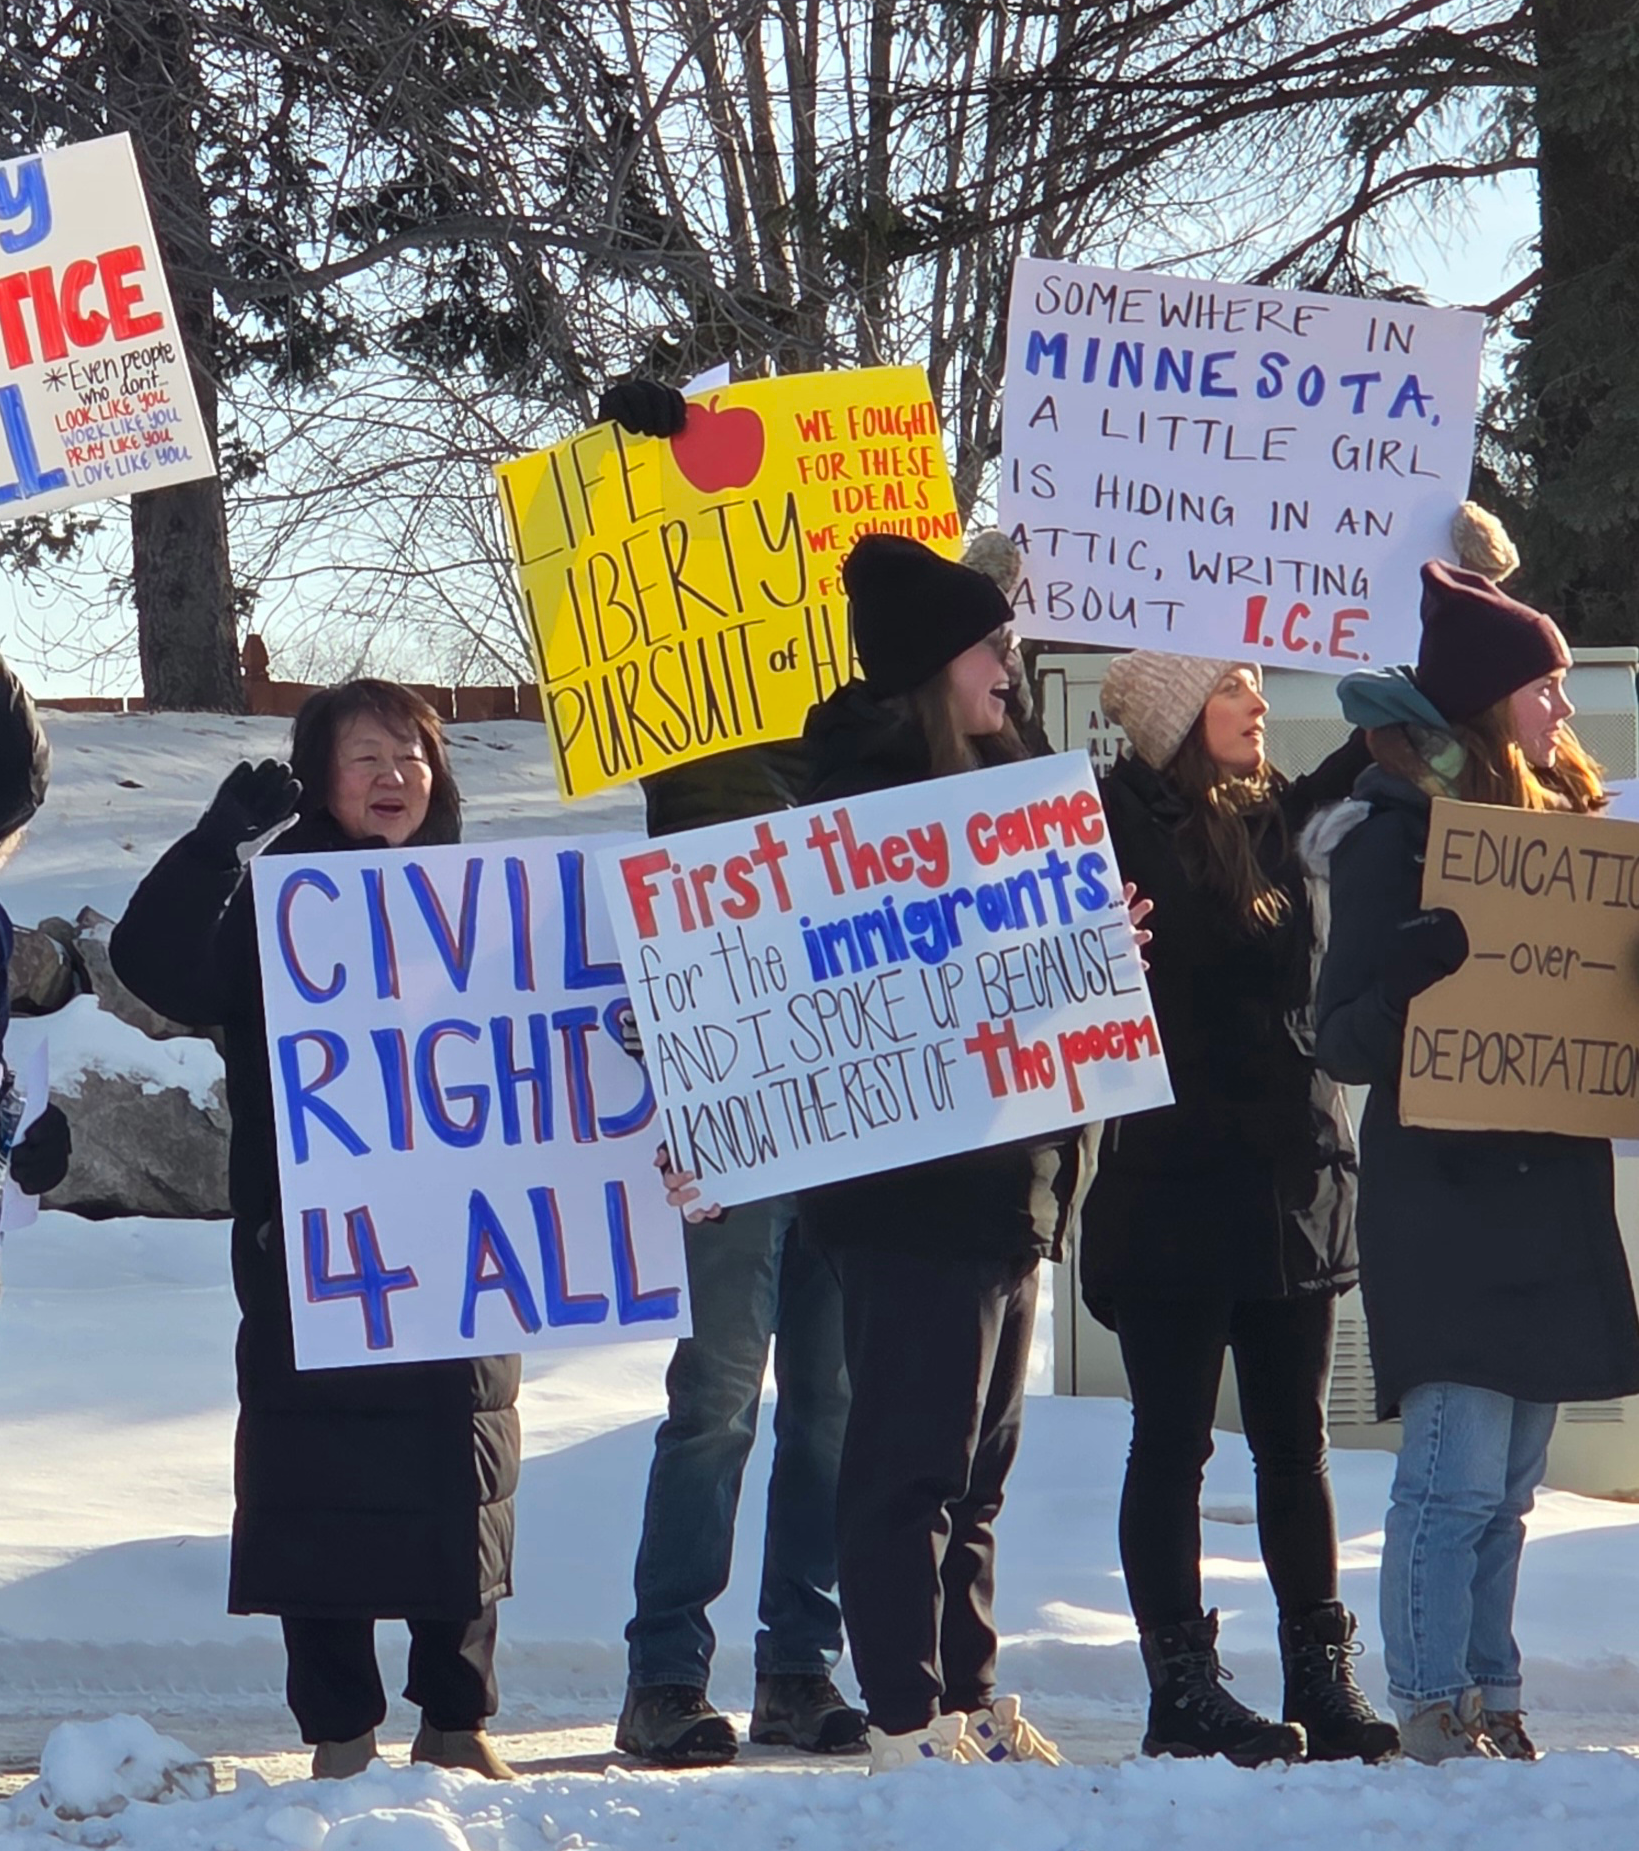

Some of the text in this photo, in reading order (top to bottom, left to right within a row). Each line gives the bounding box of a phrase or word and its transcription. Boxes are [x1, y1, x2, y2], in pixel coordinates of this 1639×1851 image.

[1035, 275, 1416, 354] SOMEWHERE IN
[78, 386, 109, 405] who
[121, 341, 175, 378] people
[1025, 330, 1441, 427] MINNESOTA,
[55, 389, 170, 433] LOOK LIKE YOU
[61, 407, 182, 447] WORK LIKE YOU
[66, 428, 174, 468] PRAY LIKE YOU
[795, 400, 938, 443] WE FOUGHT
[1028, 395, 1442, 480] A LITTLE GIRL
[72, 445, 193, 488] LOVE LIKE YOU
[500, 422, 666, 568] LIFE
[797, 445, 939, 485] FOR THESE
[832, 480, 930, 514] IDEALS
[1012, 458, 1394, 537] IS HIDING IN AN
[805, 523, 845, 553] WE
[1009, 522, 1369, 600] ATTIC, WRITING
[525, 491, 809, 686] LIBERTY
[1011, 577, 1370, 663] ABOUT I.C.E.
[547, 618, 767, 797] PURSUIT
[768, 637, 799, 674] of
[619, 789, 1106, 940] First they came
[276, 850, 625, 1004] CIVIL
[638, 944, 704, 1022] for
[710, 925, 788, 1007] the
[656, 921, 1142, 1098] AND I SPOKE UP BECAUSE
[277, 997, 658, 1165] RIGHTS
[664, 1106, 684, 1173] I
[687, 1090, 779, 1180] KNOW
[922, 1037, 961, 1111] OF
[964, 1017, 1058, 1099] the
[1058, 1012, 1161, 1115] poem
[1410, 1025, 1639, 1099] DEPORTATIO
[300, 1180, 681, 1351] 4 ALL
